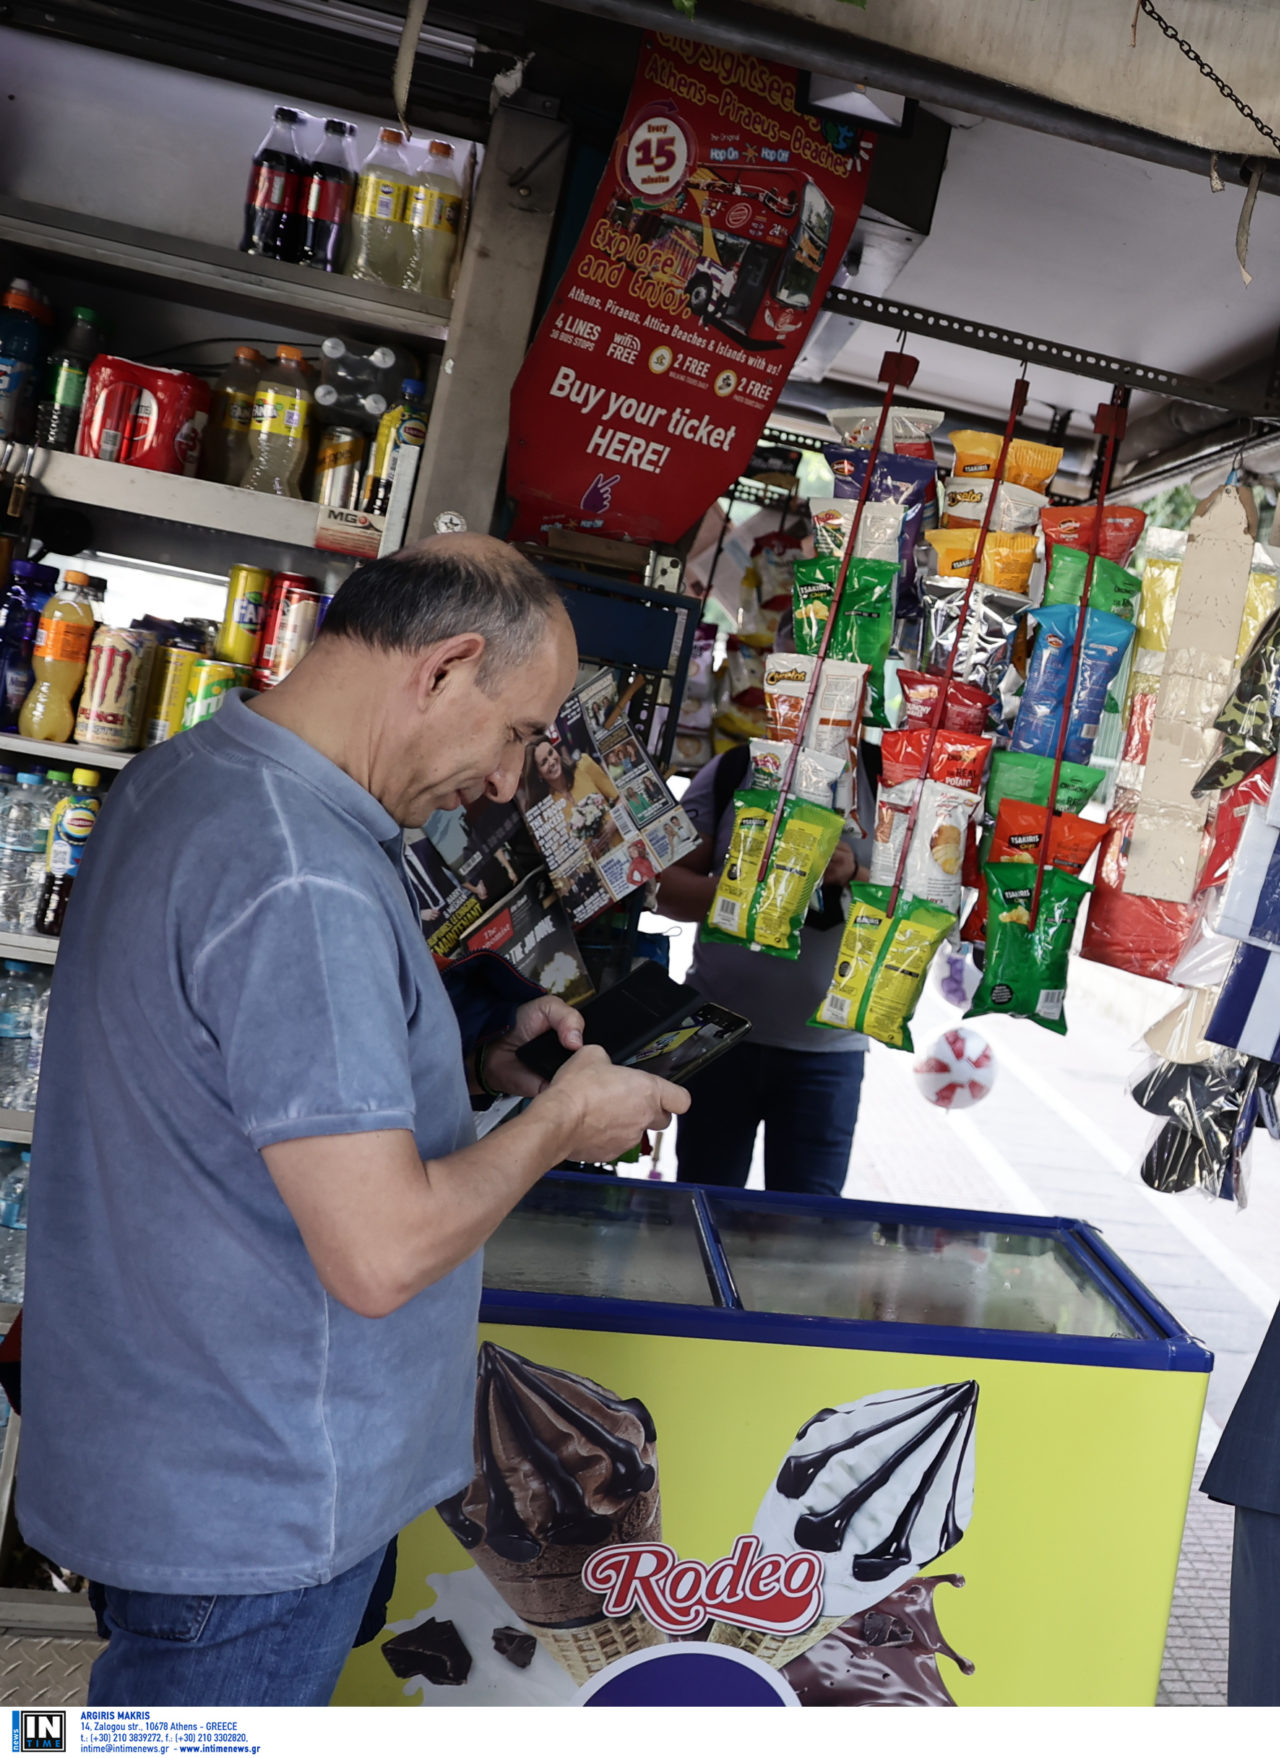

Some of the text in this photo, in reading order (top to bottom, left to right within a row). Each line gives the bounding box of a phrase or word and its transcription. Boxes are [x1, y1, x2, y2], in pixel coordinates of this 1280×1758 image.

[644, 54, 707, 107] Athens
[719, 88, 780, 143] Piraeus
[790, 125, 850, 178] Beaches
[647, 124, 668, 134] Every
[636, 137, 676, 172] 15
[710, 147, 726, 162] Hop
[727, 146, 739, 160] On
[641, 175, 670, 185] minutes
[590, 218, 676, 275] Explore
[578, 254, 693, 320] and Enjoy.
[555, 312, 602, 341] 4 LINES
[559, 331, 573, 345] BUS
[573, 334, 595, 352] STOPS
[613, 332, 632, 347] wifi
[644, 314, 671, 335] Attica
[670, 324, 707, 350] Beaches
[708, 337, 716, 351] &
[715, 340, 747, 365] Islands
[747, 352, 766, 371] with
[766, 363, 783, 377] us!
[606, 345, 639, 365] FREE
[674, 353, 711, 378] 2 FREE
[737, 377, 773, 401] 2 FREE
[549, 365, 737, 452] Buy your ticket
[585, 425, 671, 474] HERE!
[78, 707, 125, 725] PUNCH
[1011, 835, 1039, 845] TSAKIRIS
[585, 1537, 822, 1632] Rodeo
